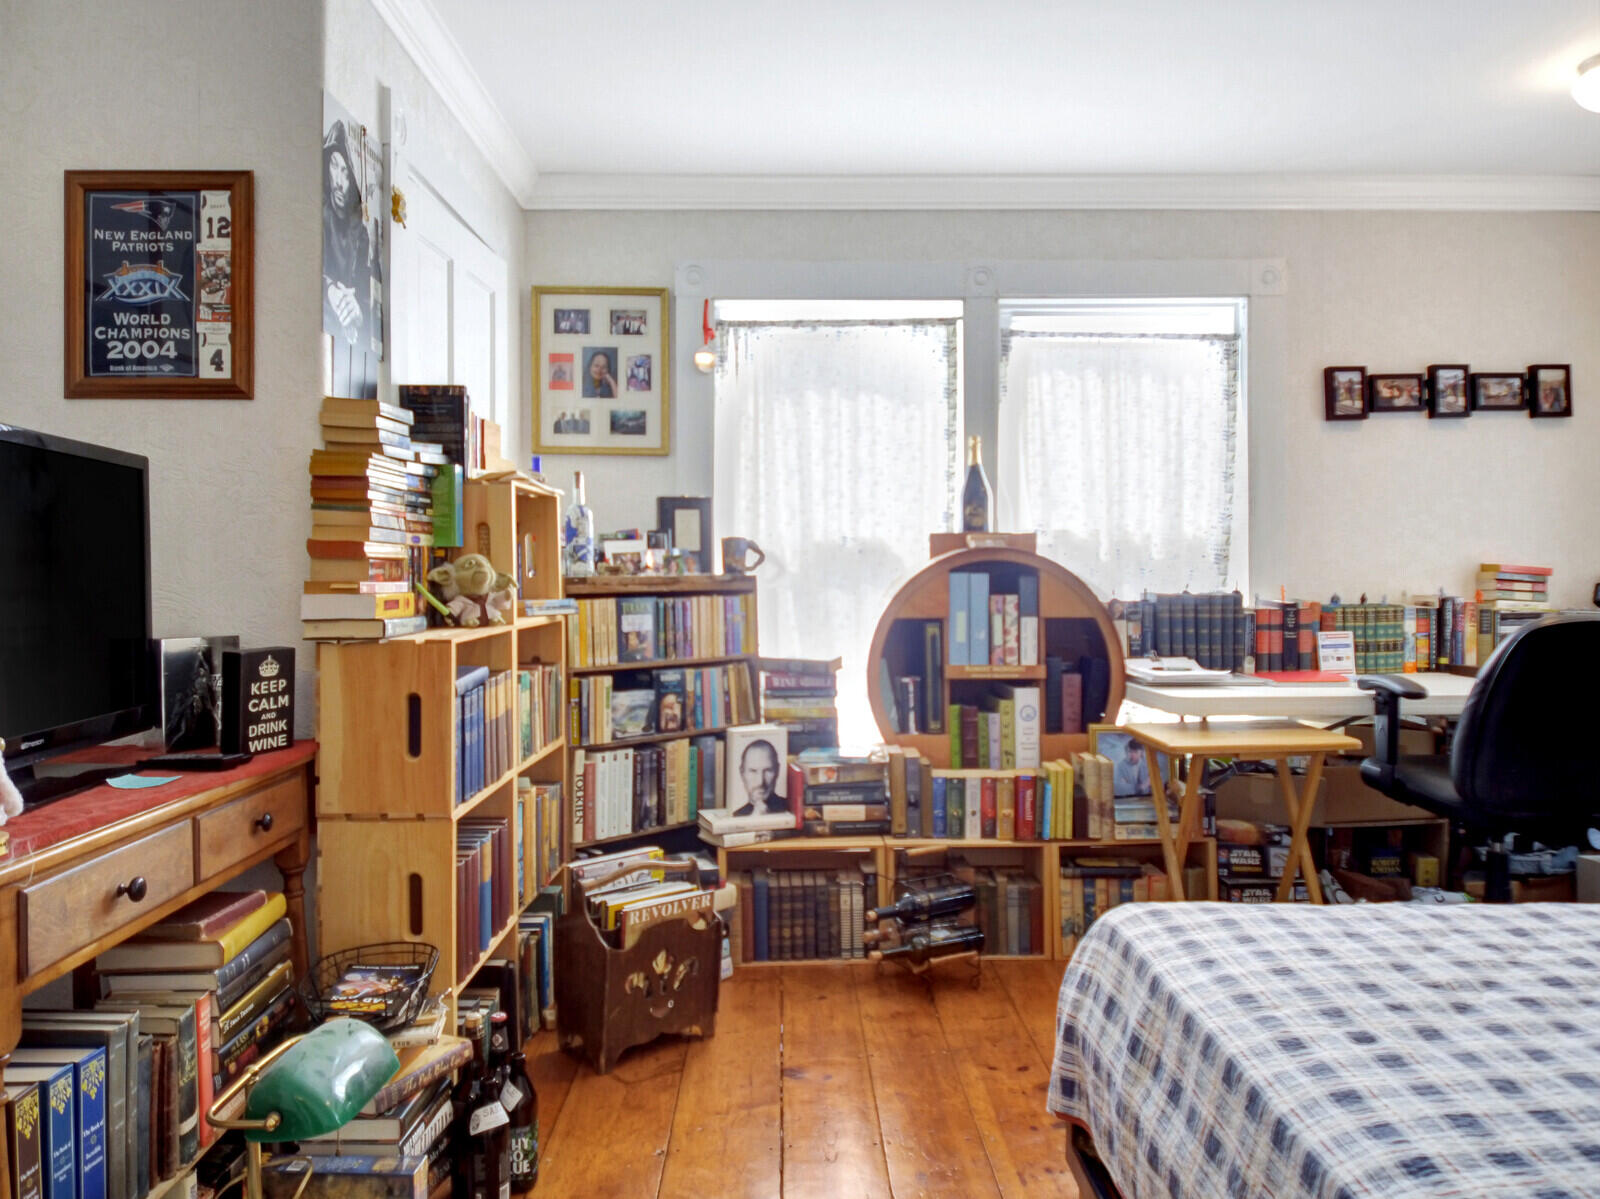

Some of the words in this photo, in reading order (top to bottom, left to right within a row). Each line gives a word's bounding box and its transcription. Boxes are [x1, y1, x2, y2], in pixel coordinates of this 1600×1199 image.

[94, 228, 125, 240] NEW
[130, 230, 193, 241] ENGLAND
[206, 216, 231, 239] 12
[112, 241, 174, 252] PATRIOTS
[113, 312, 171, 326] WORLD
[94, 326, 191, 340] CHAMPIONS
[106, 340, 178, 359] 2004
[210, 348, 224, 372] 4
[250, 679, 288, 696] KEEP
[248, 694, 290, 713] CALM
[260, 712, 277, 721] AND
[248, 719, 288, 738] DRINK
[248, 734, 288, 753] WINE
[575, 773, 585, 825] TOLKIEN
[1230, 849, 1261, 858] STAR
[1230, 857, 1261, 865] WARS
[1242, 888, 1272, 897] STAR
[629, 894, 712, 926] REVOLVER
[510, 1137, 529, 1151] HY
